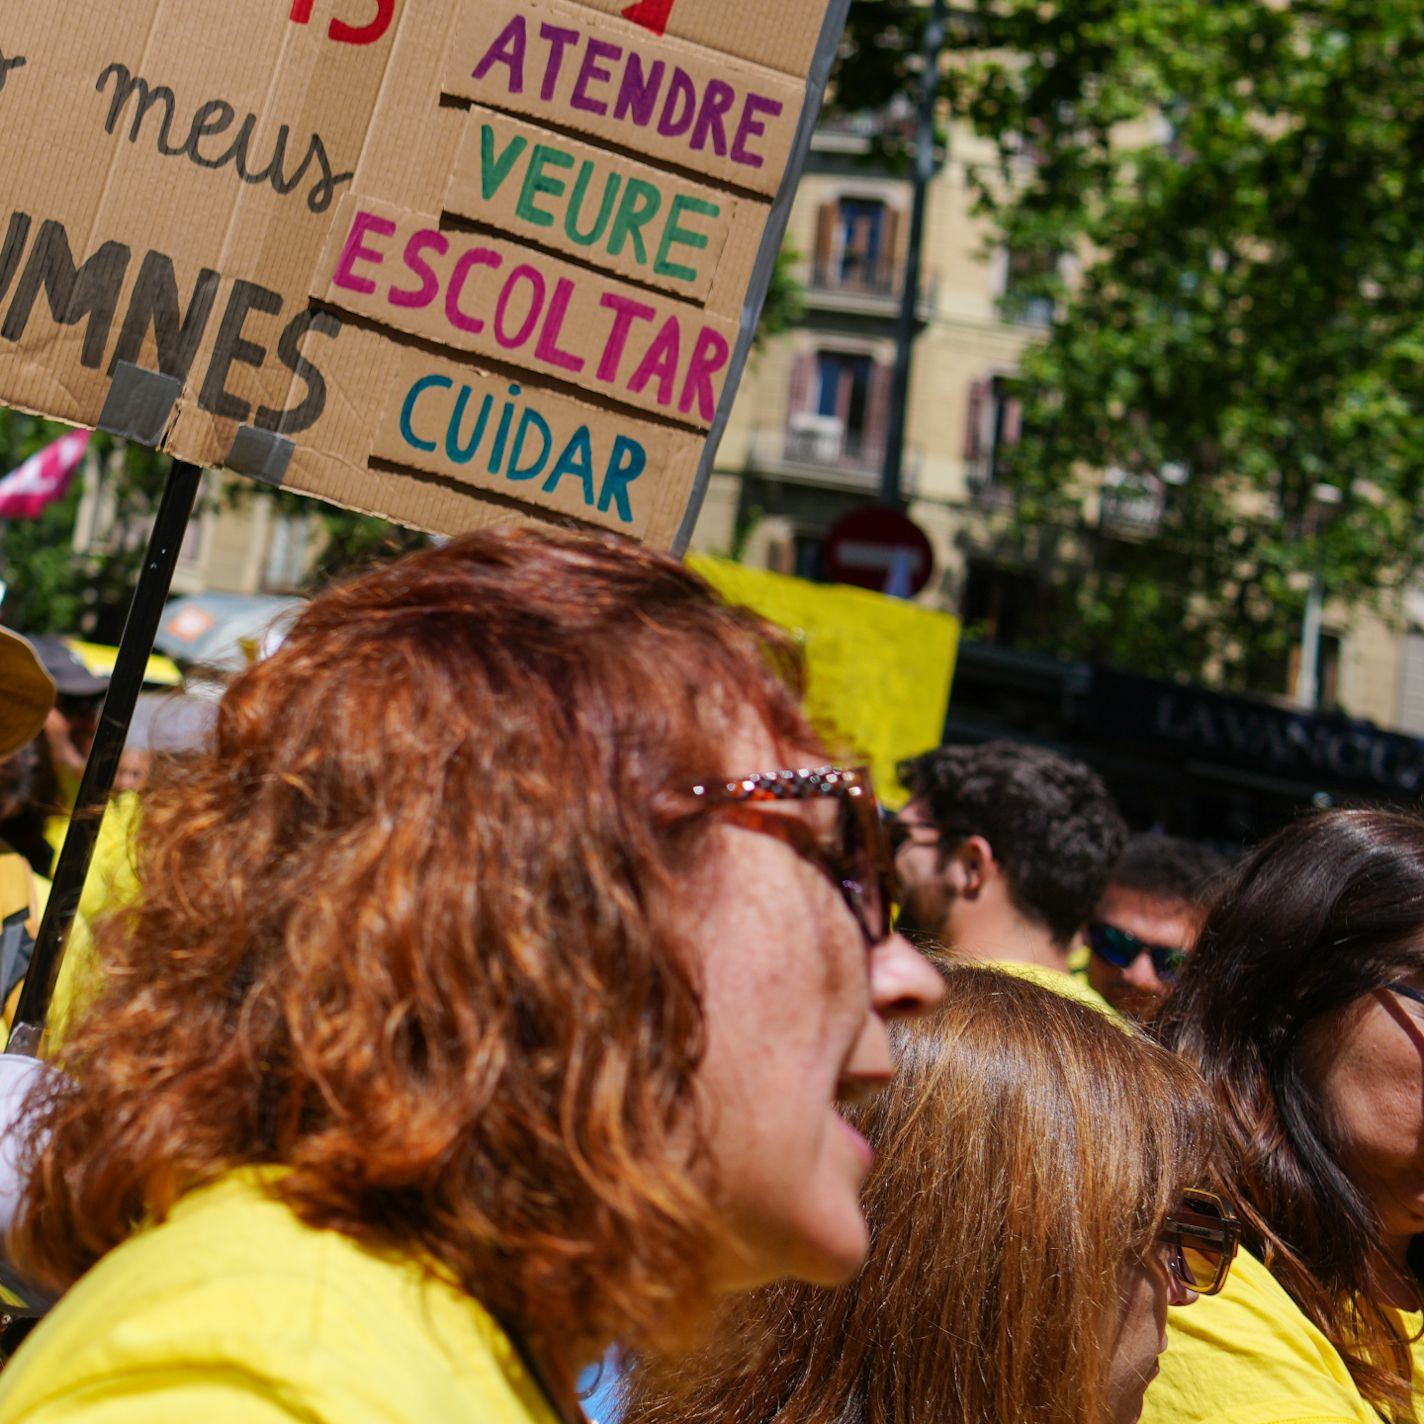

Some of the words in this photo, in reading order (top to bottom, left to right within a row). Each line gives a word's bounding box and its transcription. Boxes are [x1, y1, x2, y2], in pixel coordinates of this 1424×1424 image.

[95, 63, 355, 214] meus
[472, 14, 784, 169] ATENDRE
[480, 124, 721, 282] VEURE
[332, 211, 730, 423] ESCOLTAR
